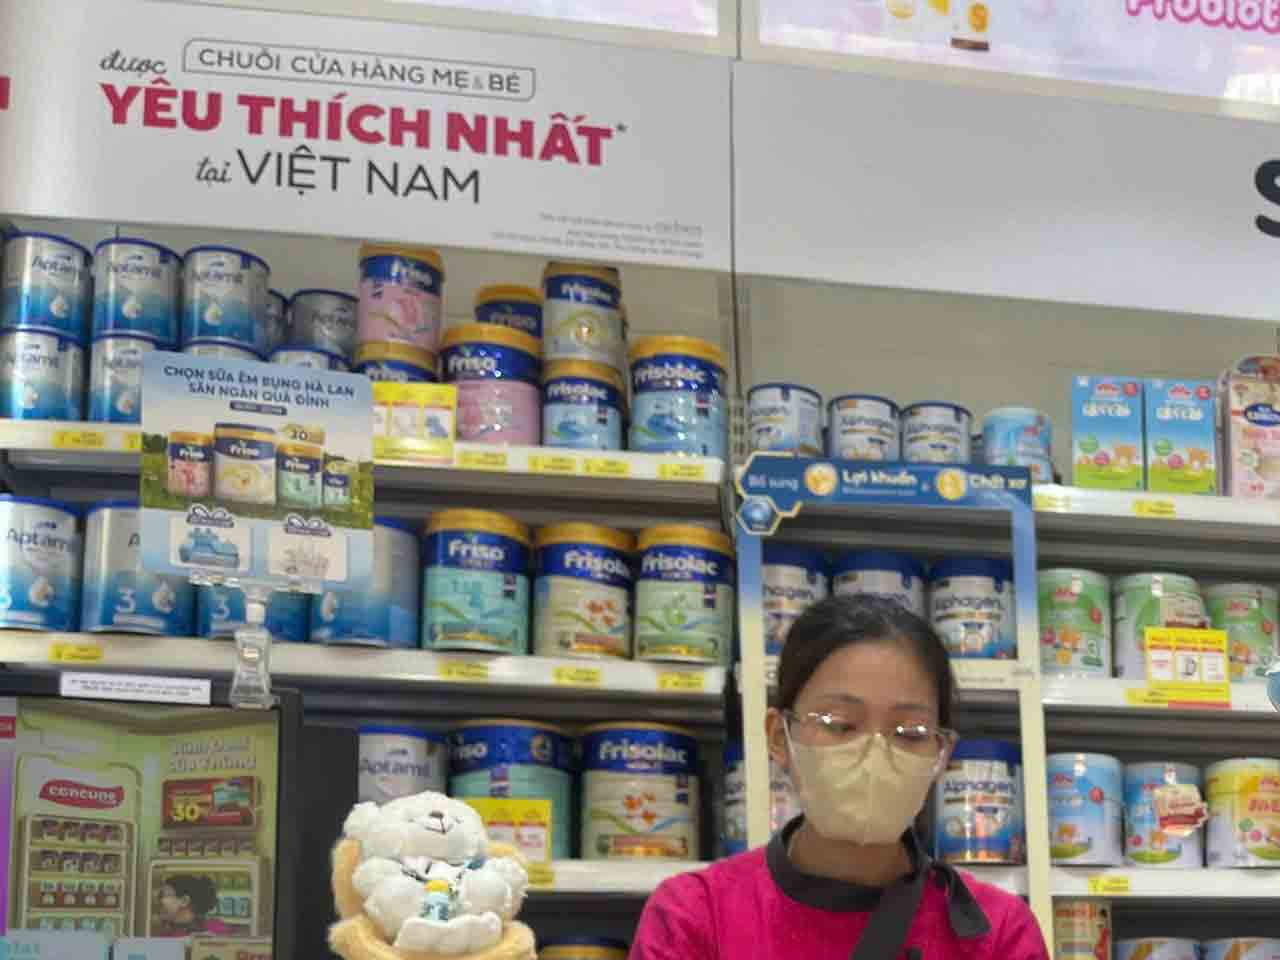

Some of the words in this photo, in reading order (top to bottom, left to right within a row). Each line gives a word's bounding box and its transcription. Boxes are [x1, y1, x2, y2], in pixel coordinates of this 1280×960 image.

[100, 50, 168, 77] được
[199, 45, 282, 75] CHUỖI
[291, 50, 344, 78] CỬA
[351, 55, 425, 85] HÀNG
[433, 68, 470, 92] MẸ
[488, 68, 521, 94] BÉ
[99, 78, 223, 131] YÊU
[238, 92, 431, 149] THÍCH
[196, 158, 232, 185] tại
[238, 145, 352, 194] VIỆT
[367, 162, 482, 204] NAM
